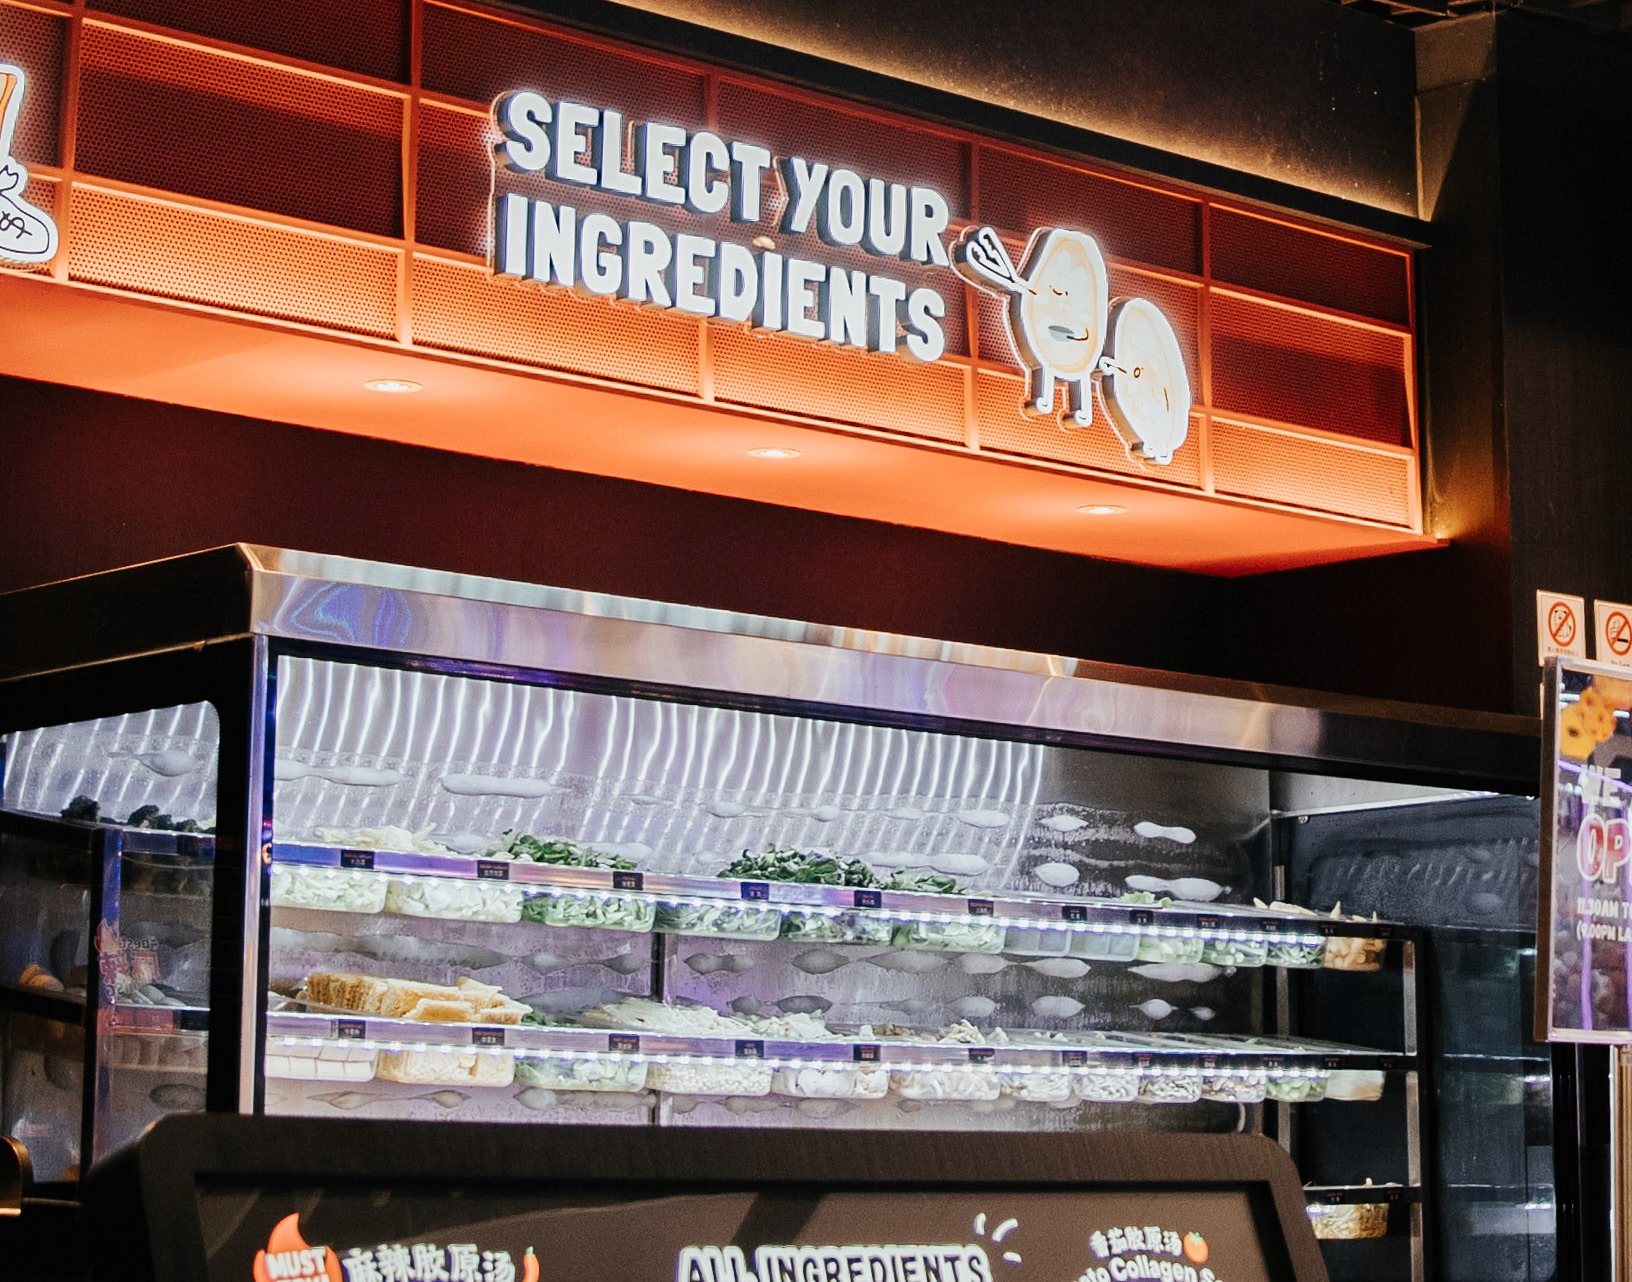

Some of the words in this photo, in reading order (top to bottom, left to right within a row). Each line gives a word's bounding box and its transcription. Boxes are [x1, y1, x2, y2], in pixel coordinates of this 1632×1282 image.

[503, 92, 770, 223] SELECT
[784, 158, 949, 267] YOUR
[500, 193, 945, 364] INGREDIENTS
[1579, 765, 1621, 806] WE
[266, 1247, 327, 1280] MUST
[680, 1246, 756, 1282] ALL
[757, 1245, 992, 1282] INGREDIENTS
[1109, 1254, 1199, 1282] Collagen
